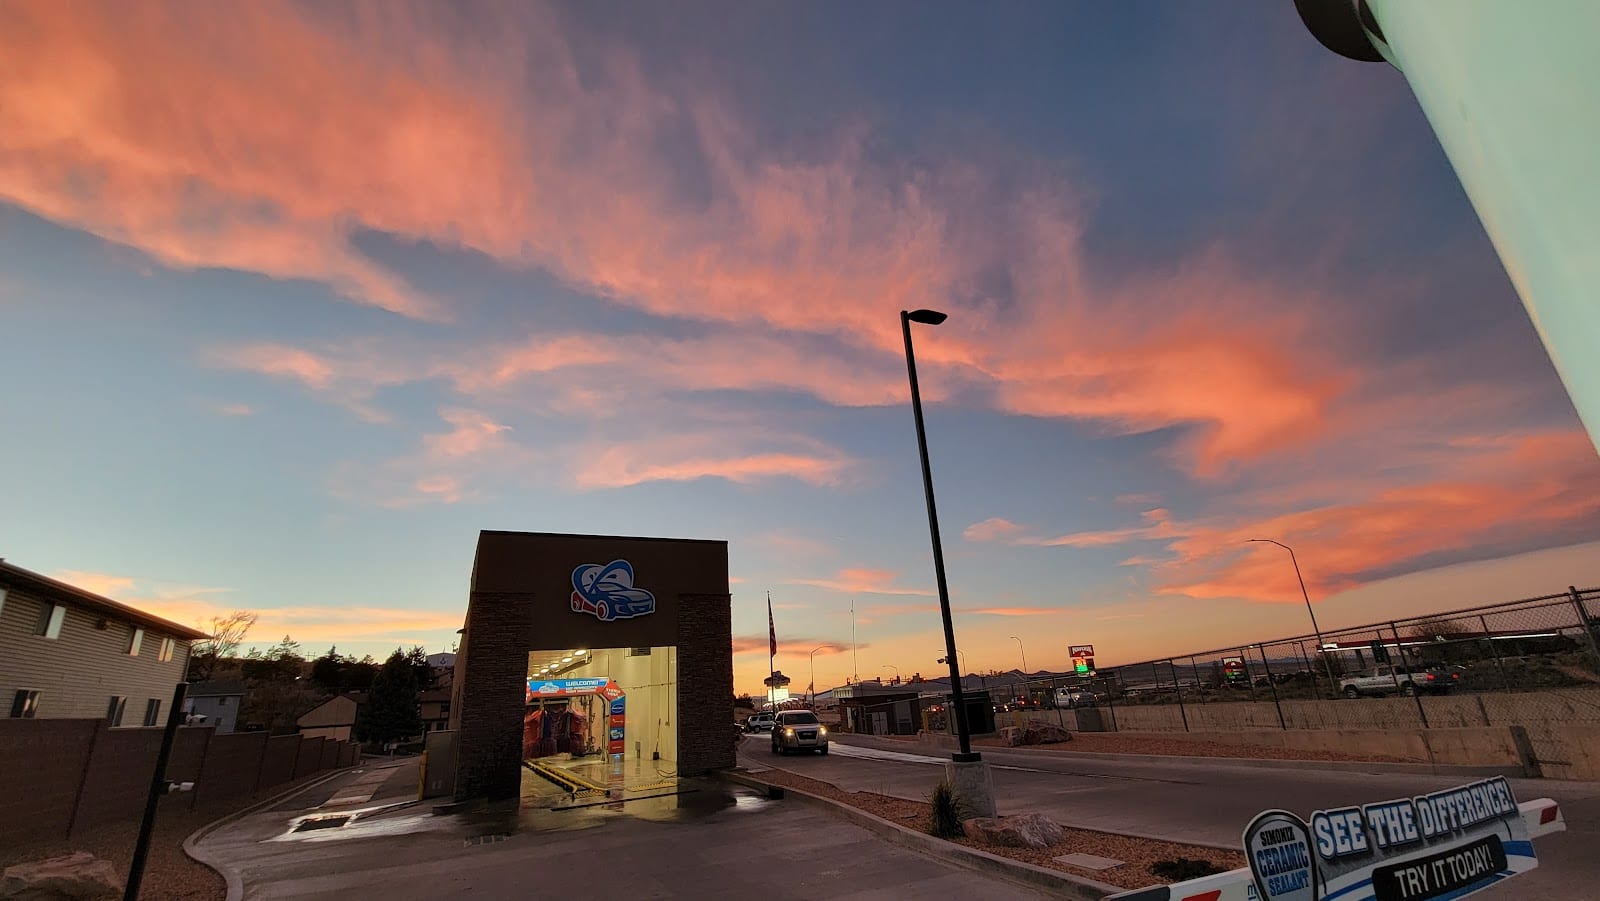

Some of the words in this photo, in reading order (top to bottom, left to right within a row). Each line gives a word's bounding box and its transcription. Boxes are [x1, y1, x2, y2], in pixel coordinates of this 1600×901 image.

[1260, 827, 1295, 847] SIMONIZ
[1313, 812, 1367, 859] SEE
[1367, 803, 1419, 849] THE
[1416, 779, 1515, 839] DIFFERENCE!
[1256, 842, 1309, 878] CERAMIC
[1393, 863, 1430, 899] TRY
[1430, 859, 1448, 889] IT
[1447, 844, 1496, 881] TODAY!
[1268, 870, 1309, 897] SEALANT
